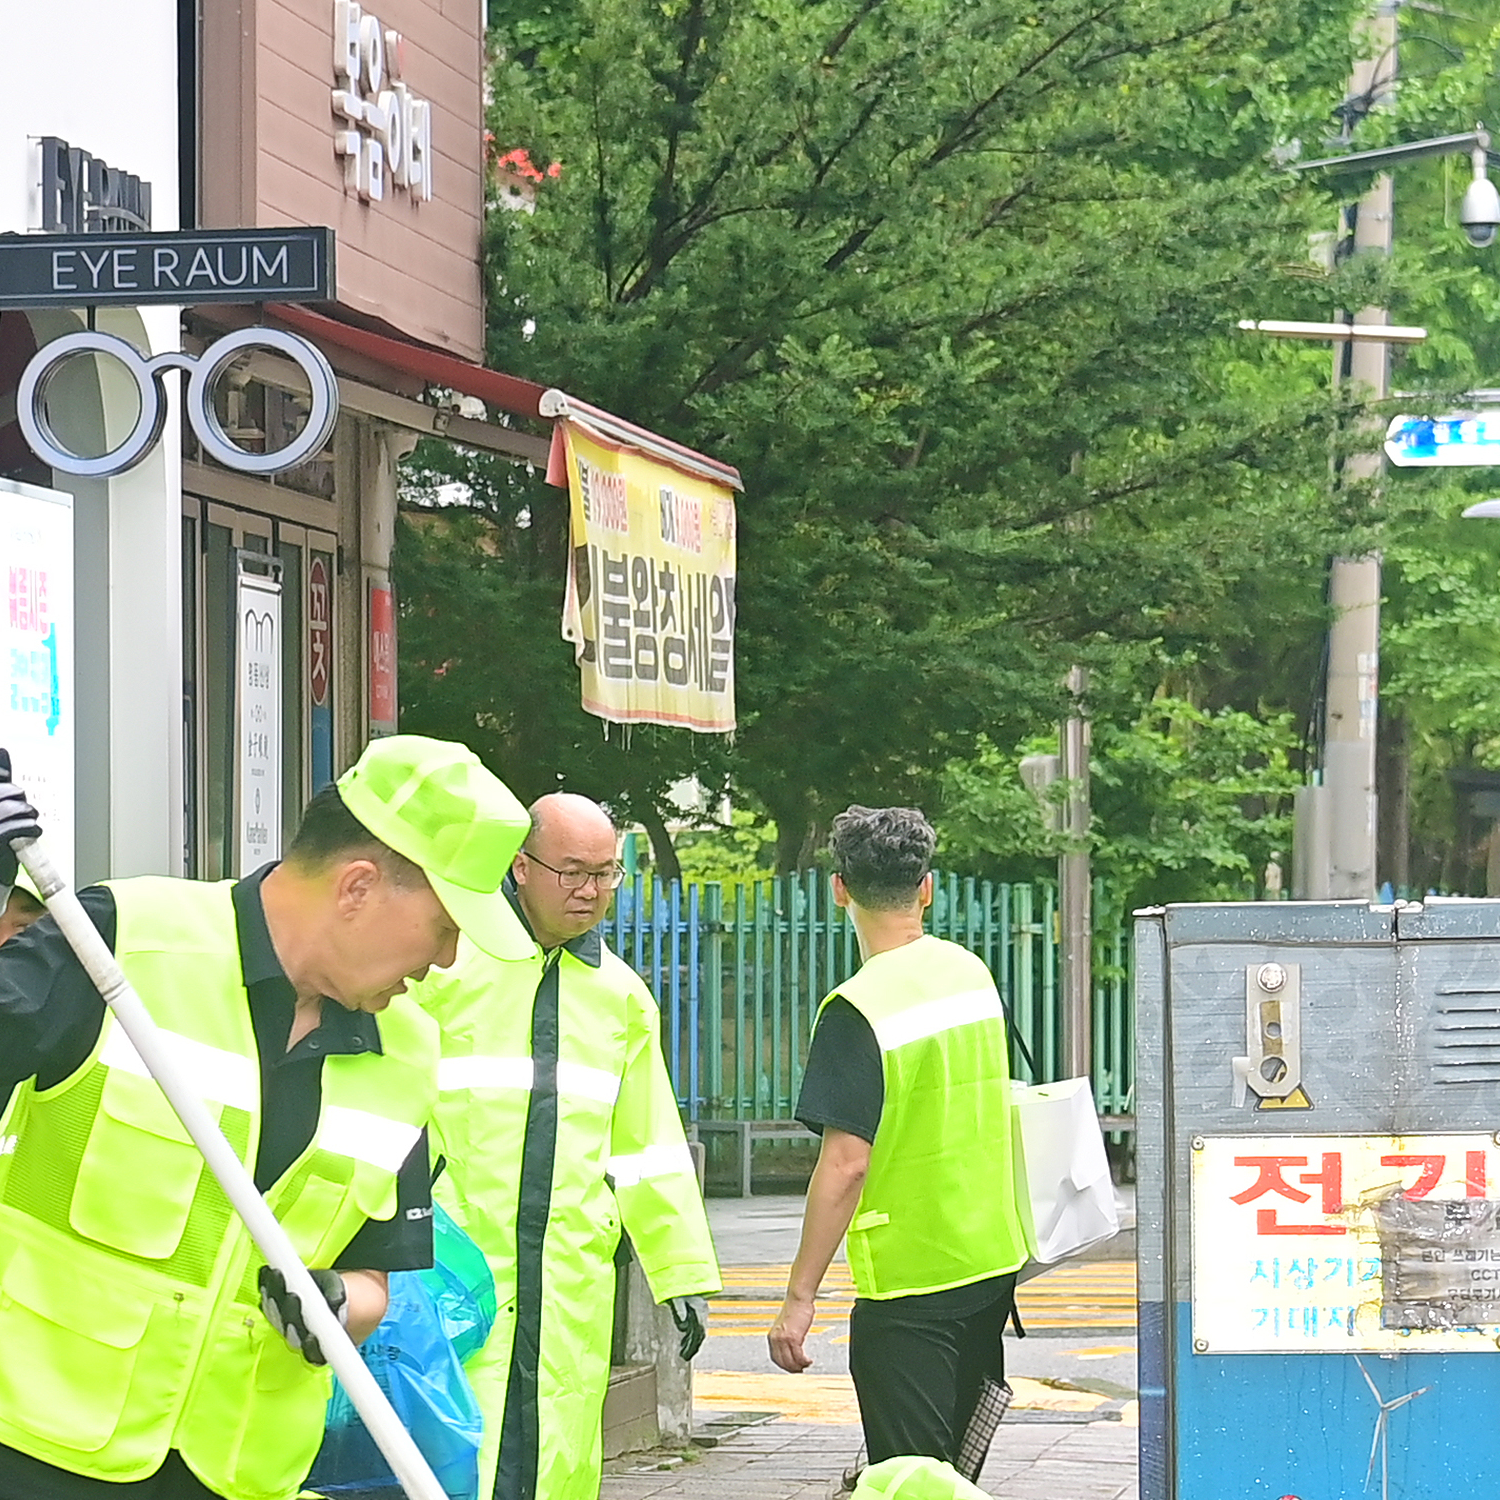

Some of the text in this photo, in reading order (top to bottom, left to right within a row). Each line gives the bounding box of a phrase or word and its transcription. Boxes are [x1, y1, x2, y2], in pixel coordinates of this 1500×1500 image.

[51, 245, 289, 291] EYE RAUM
[1452, 1249, 1500, 1262] 쓰레기는
